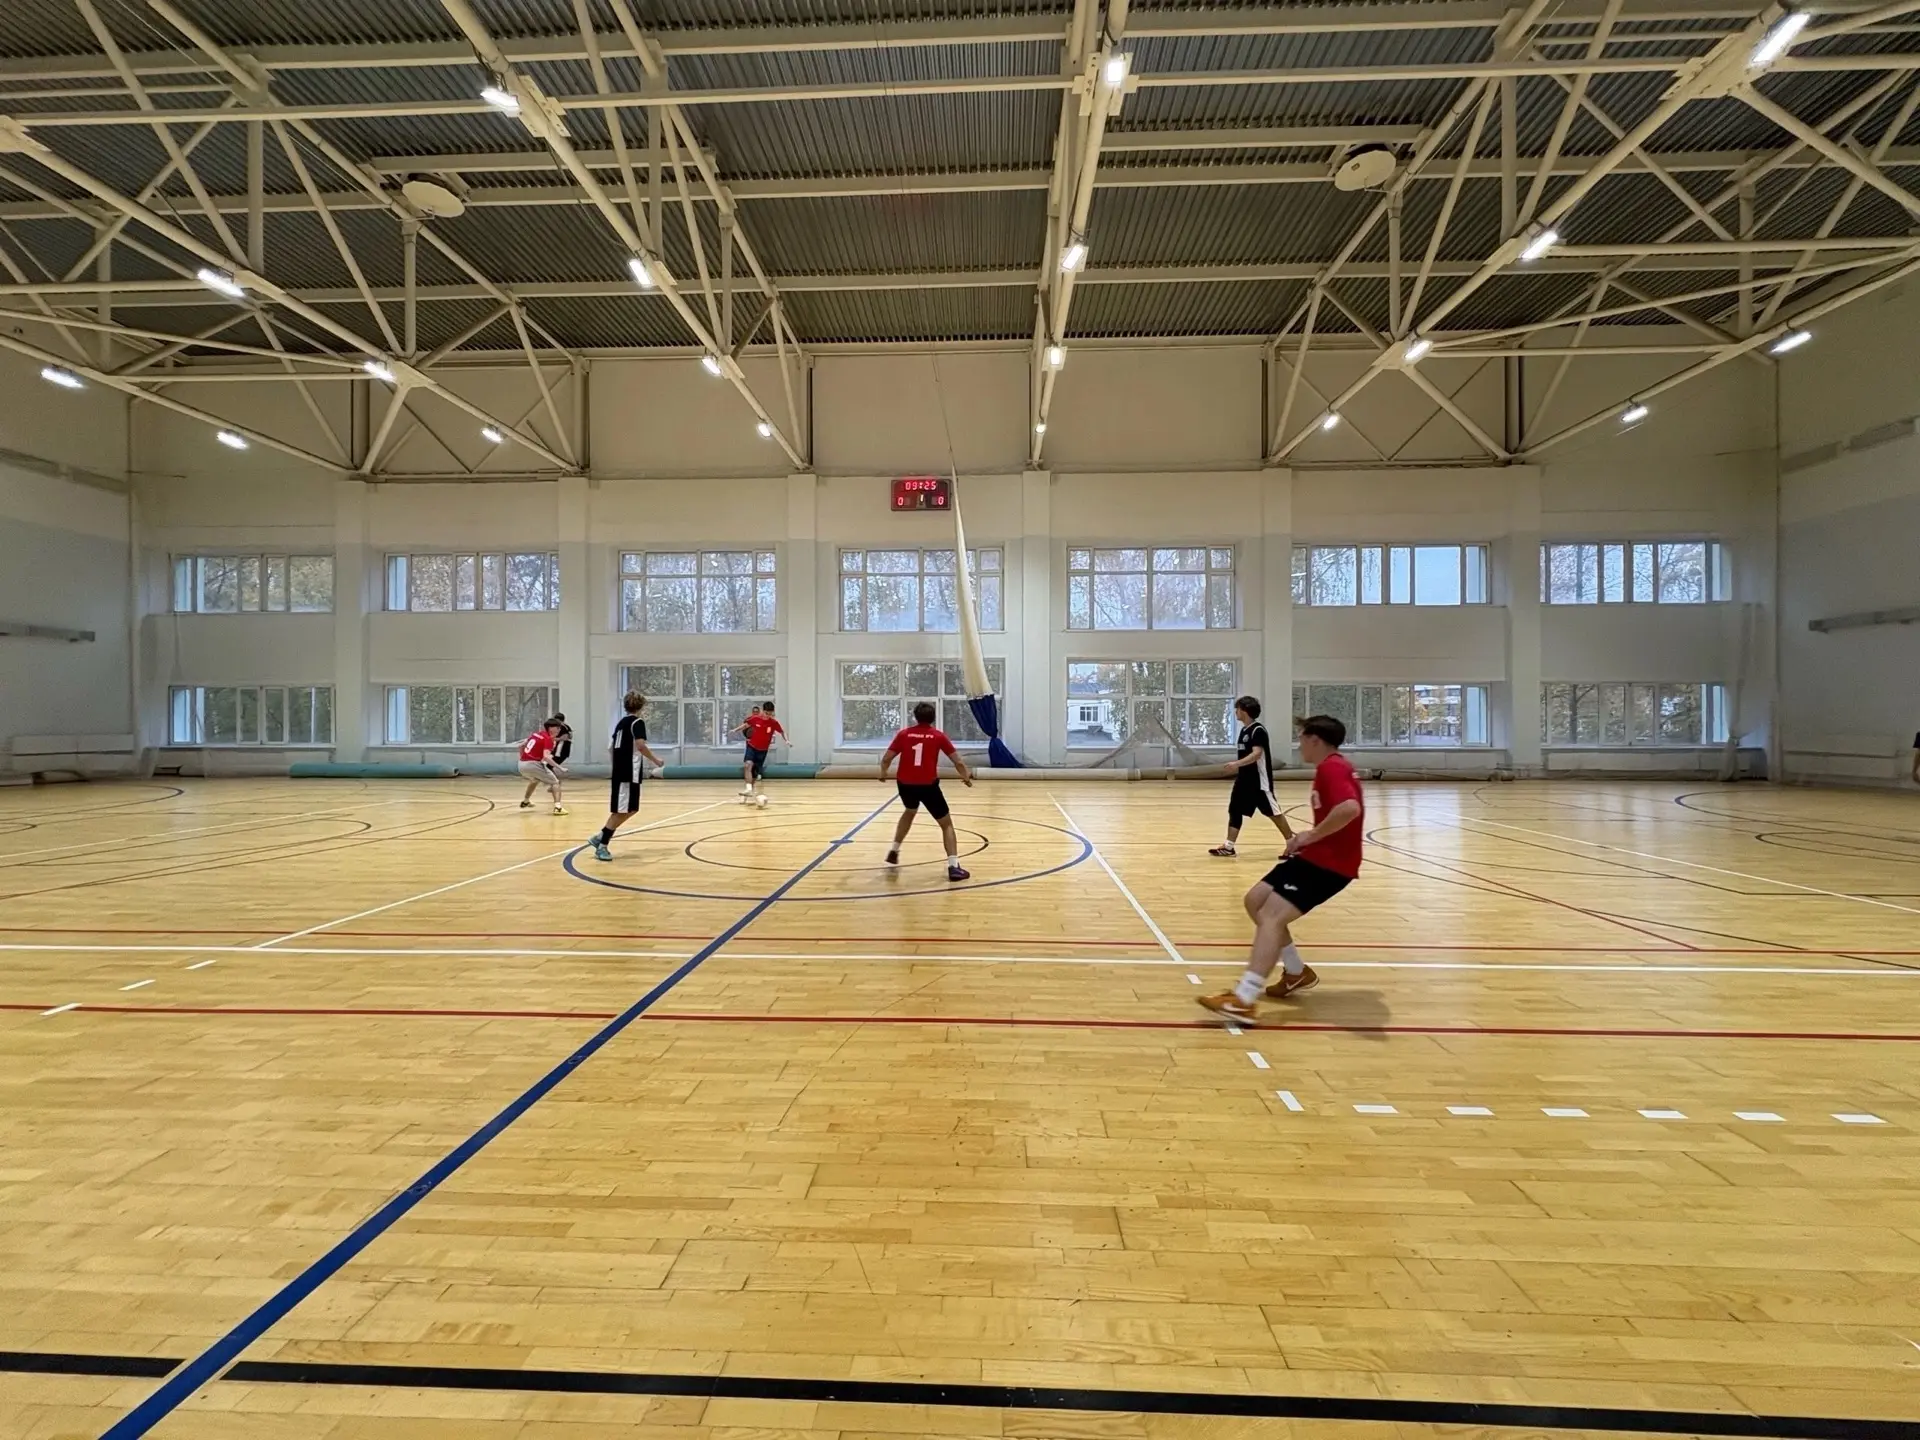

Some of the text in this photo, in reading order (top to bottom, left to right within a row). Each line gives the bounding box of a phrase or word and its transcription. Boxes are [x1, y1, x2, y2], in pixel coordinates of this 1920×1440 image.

[897, 496, 904, 506] 0
[938, 496, 945, 506] 0
[524, 738, 536, 754] 9
[911, 742, 923, 767] 1
